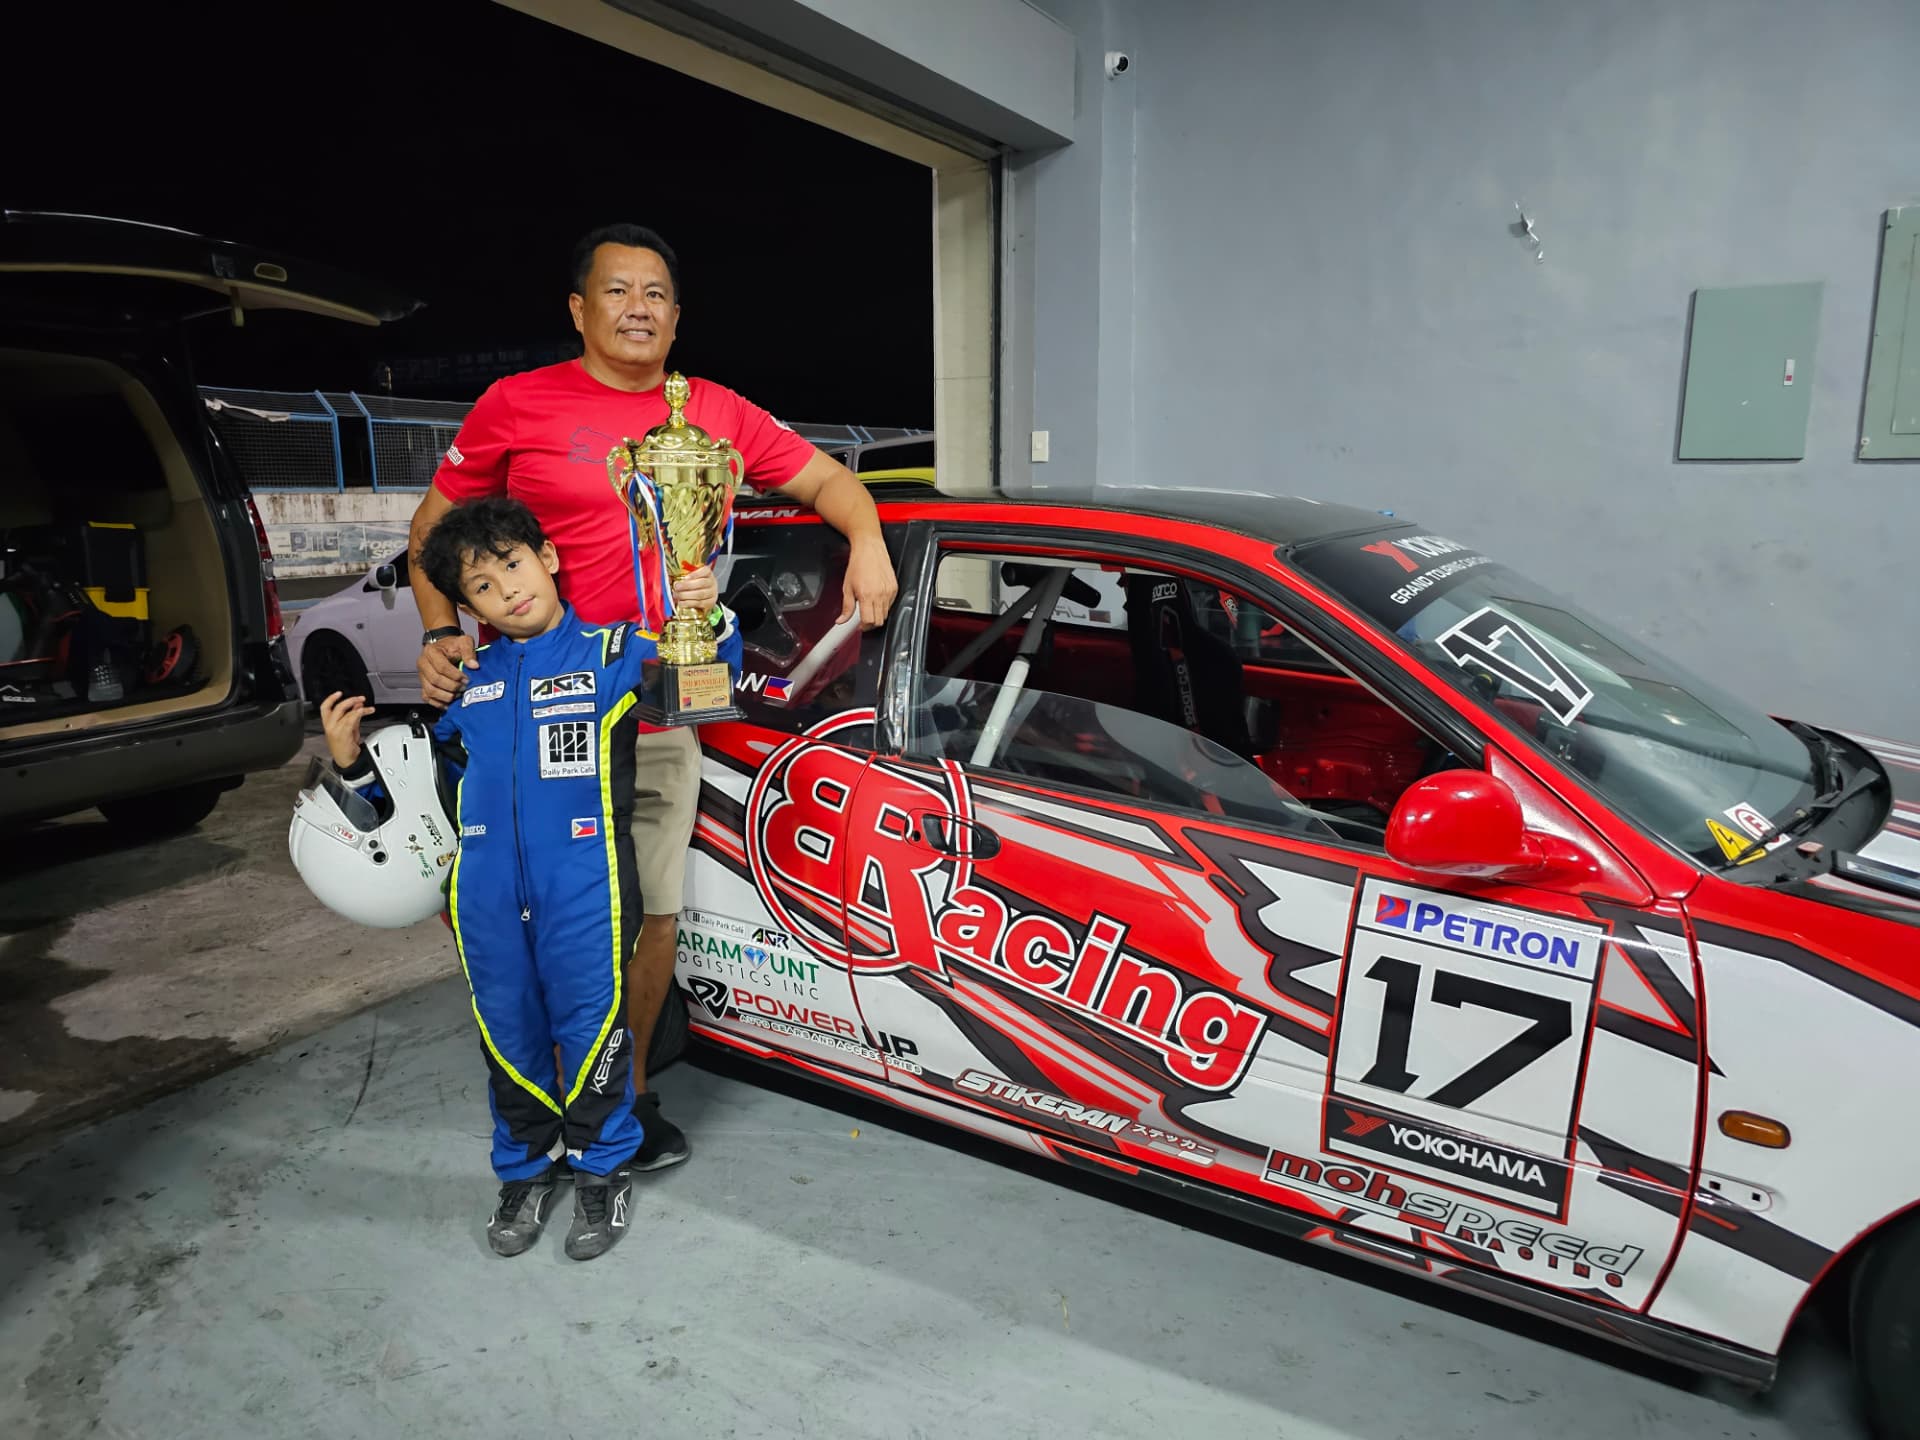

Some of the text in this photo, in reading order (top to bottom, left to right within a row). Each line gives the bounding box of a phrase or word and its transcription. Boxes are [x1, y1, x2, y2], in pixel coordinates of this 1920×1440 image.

[1390, 575, 1434, 605] GRAND
[1436, 607, 1594, 726] 17
[562, 767, 578, 775] Park
[701, 915, 715, 927] Daily
[716, 918, 730, 930] Park
[1413, 902, 1580, 969] PETRON
[678, 951, 819, 1000] OGISTICS INC
[732, 987, 920, 1057] POWER UP
[739, 1014, 771, 1029] AUTO
[771, 1021, 811, 1041] GEARS
[811, 1032, 836, 1048] AND
[1360, 956, 1573, 1109] 17
[589, 1028, 624, 1095] KERB
[1132, 1123, 1216, 1154] ステッカー
[1388, 1124, 1546, 1188] YOKOHAMA
